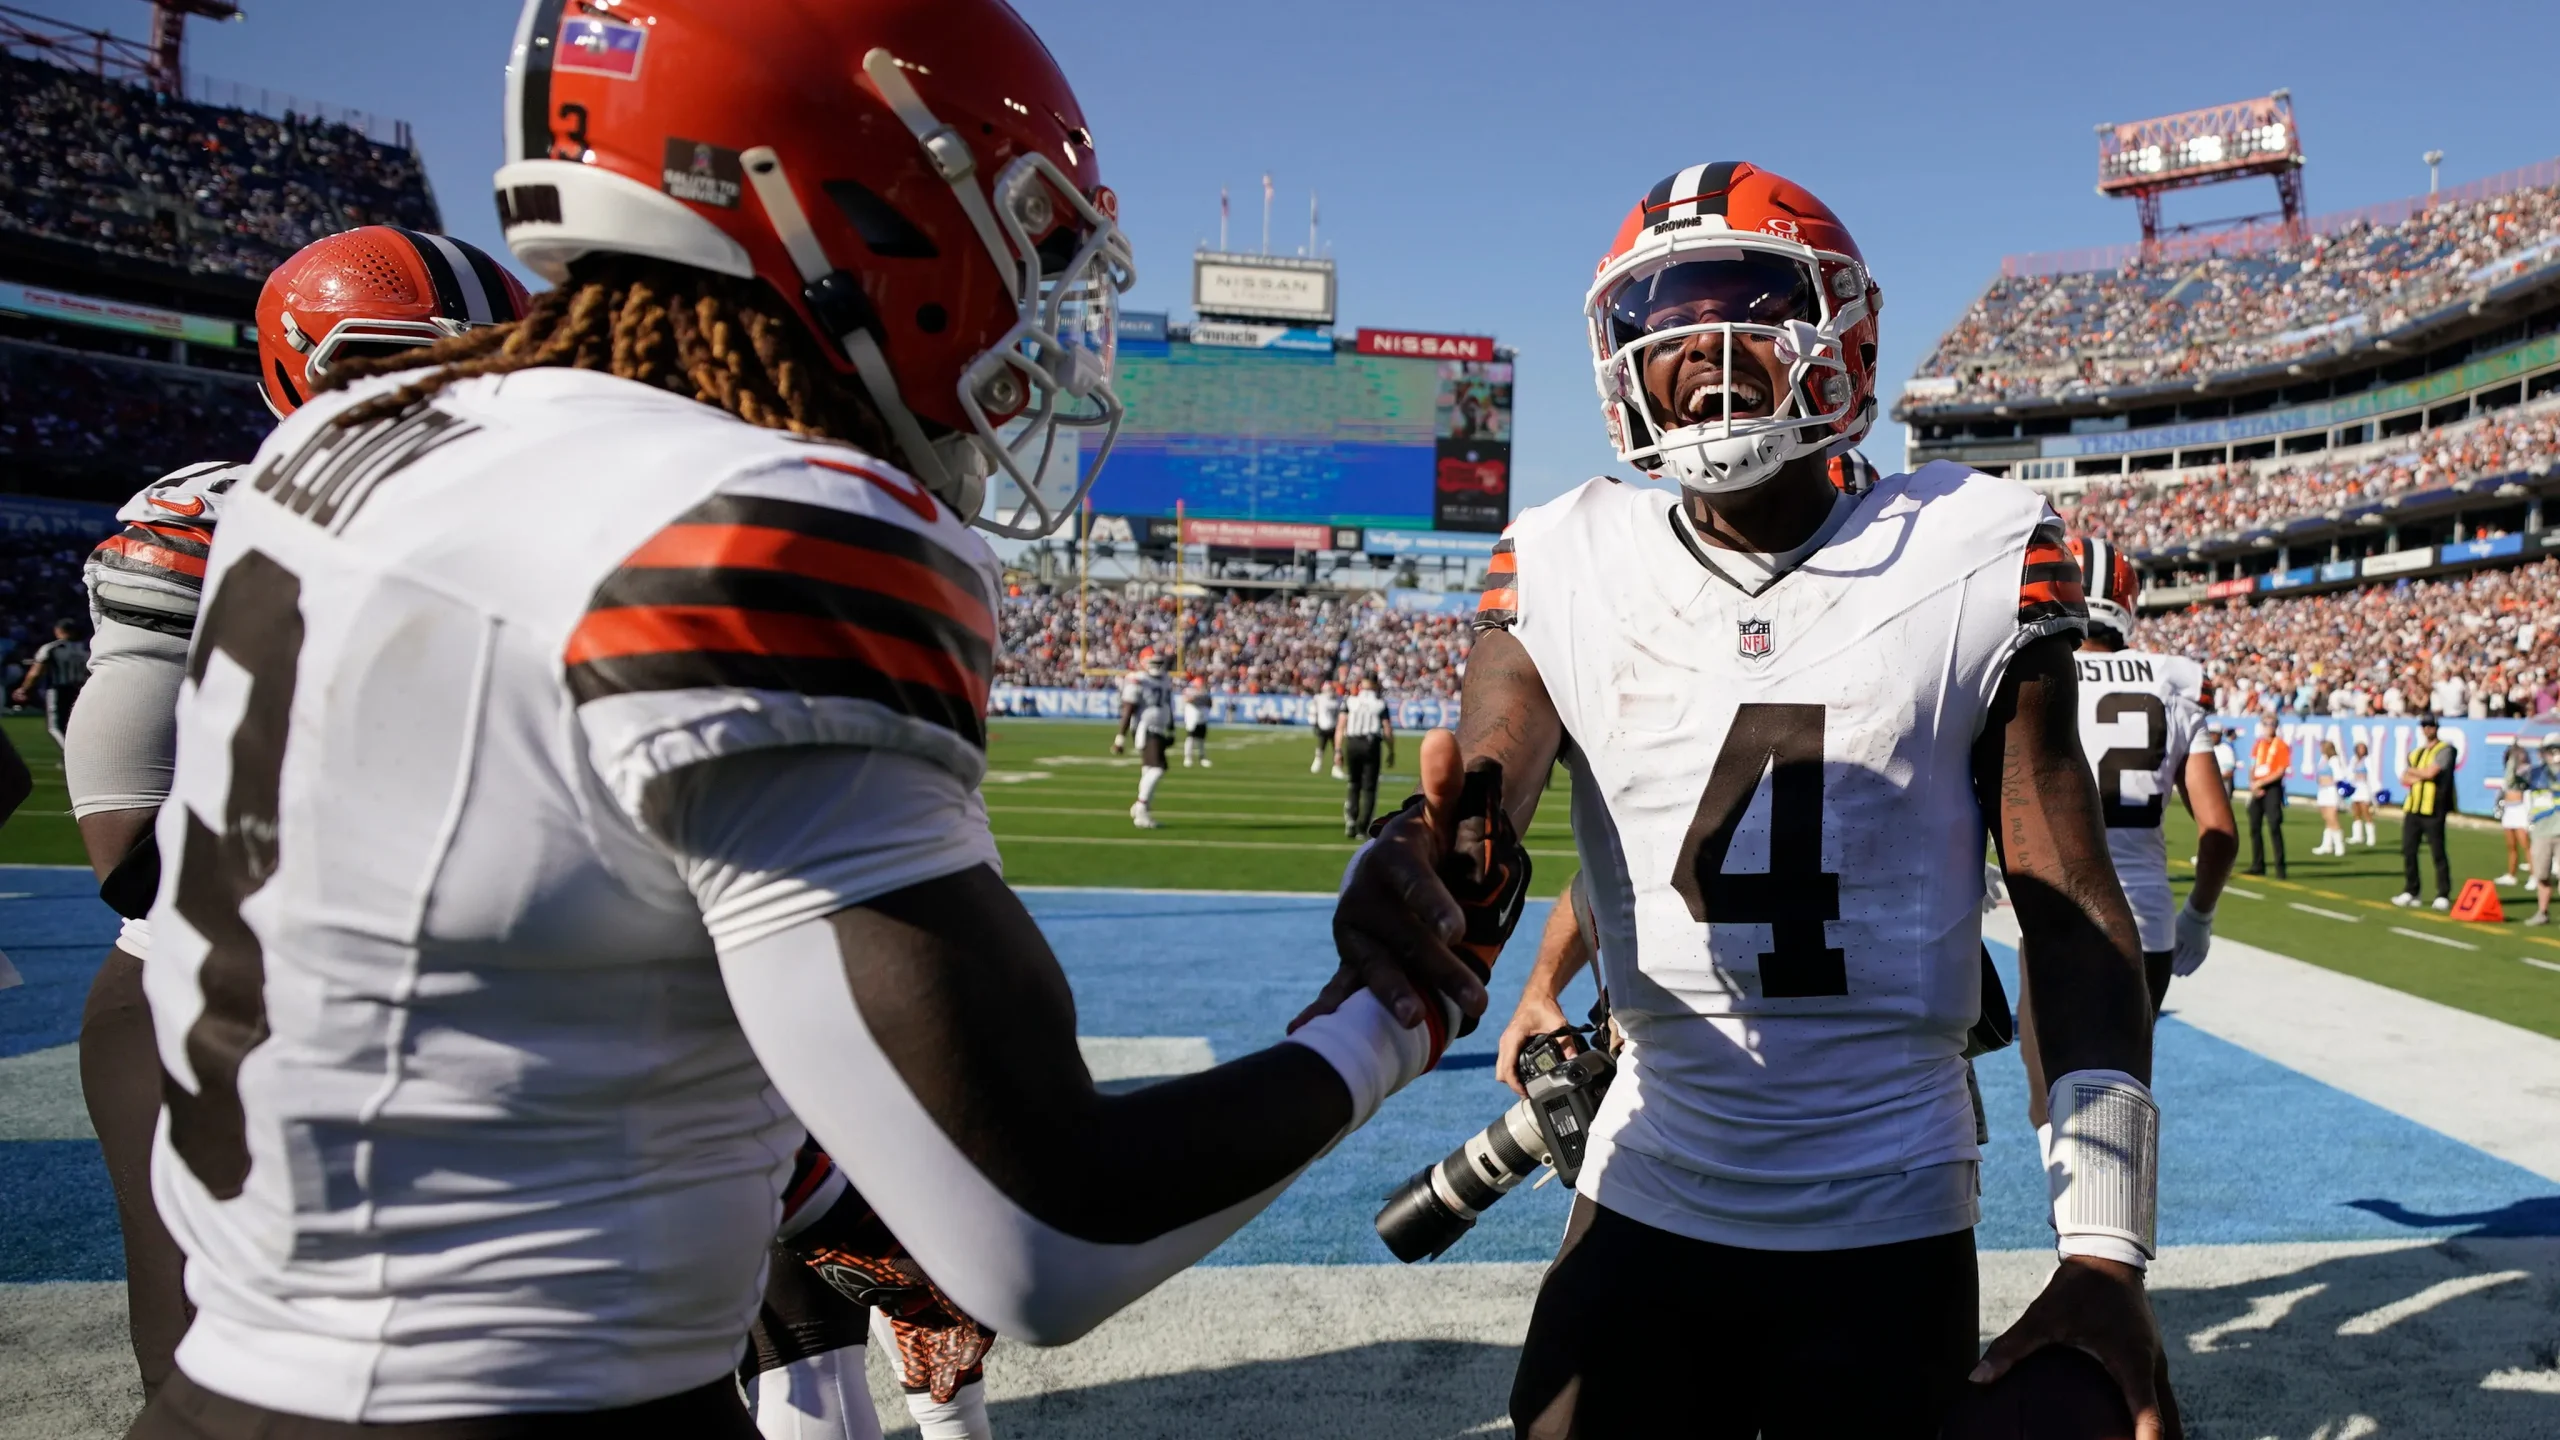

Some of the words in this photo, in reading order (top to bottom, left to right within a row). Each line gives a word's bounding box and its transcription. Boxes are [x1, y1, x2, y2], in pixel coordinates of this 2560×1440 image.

[550, 102, 592, 161] 3
[1653, 216, 1703, 236] BROWNS
[1214, 273, 1309, 294] NISSAN
[1372, 333, 1478, 358] NISSAN
[1743, 635, 1768, 653] NFL
[1670, 703, 1849, 998] 4
[162, 547, 305, 1201] 3
[2459, 883, 2484, 912] G
